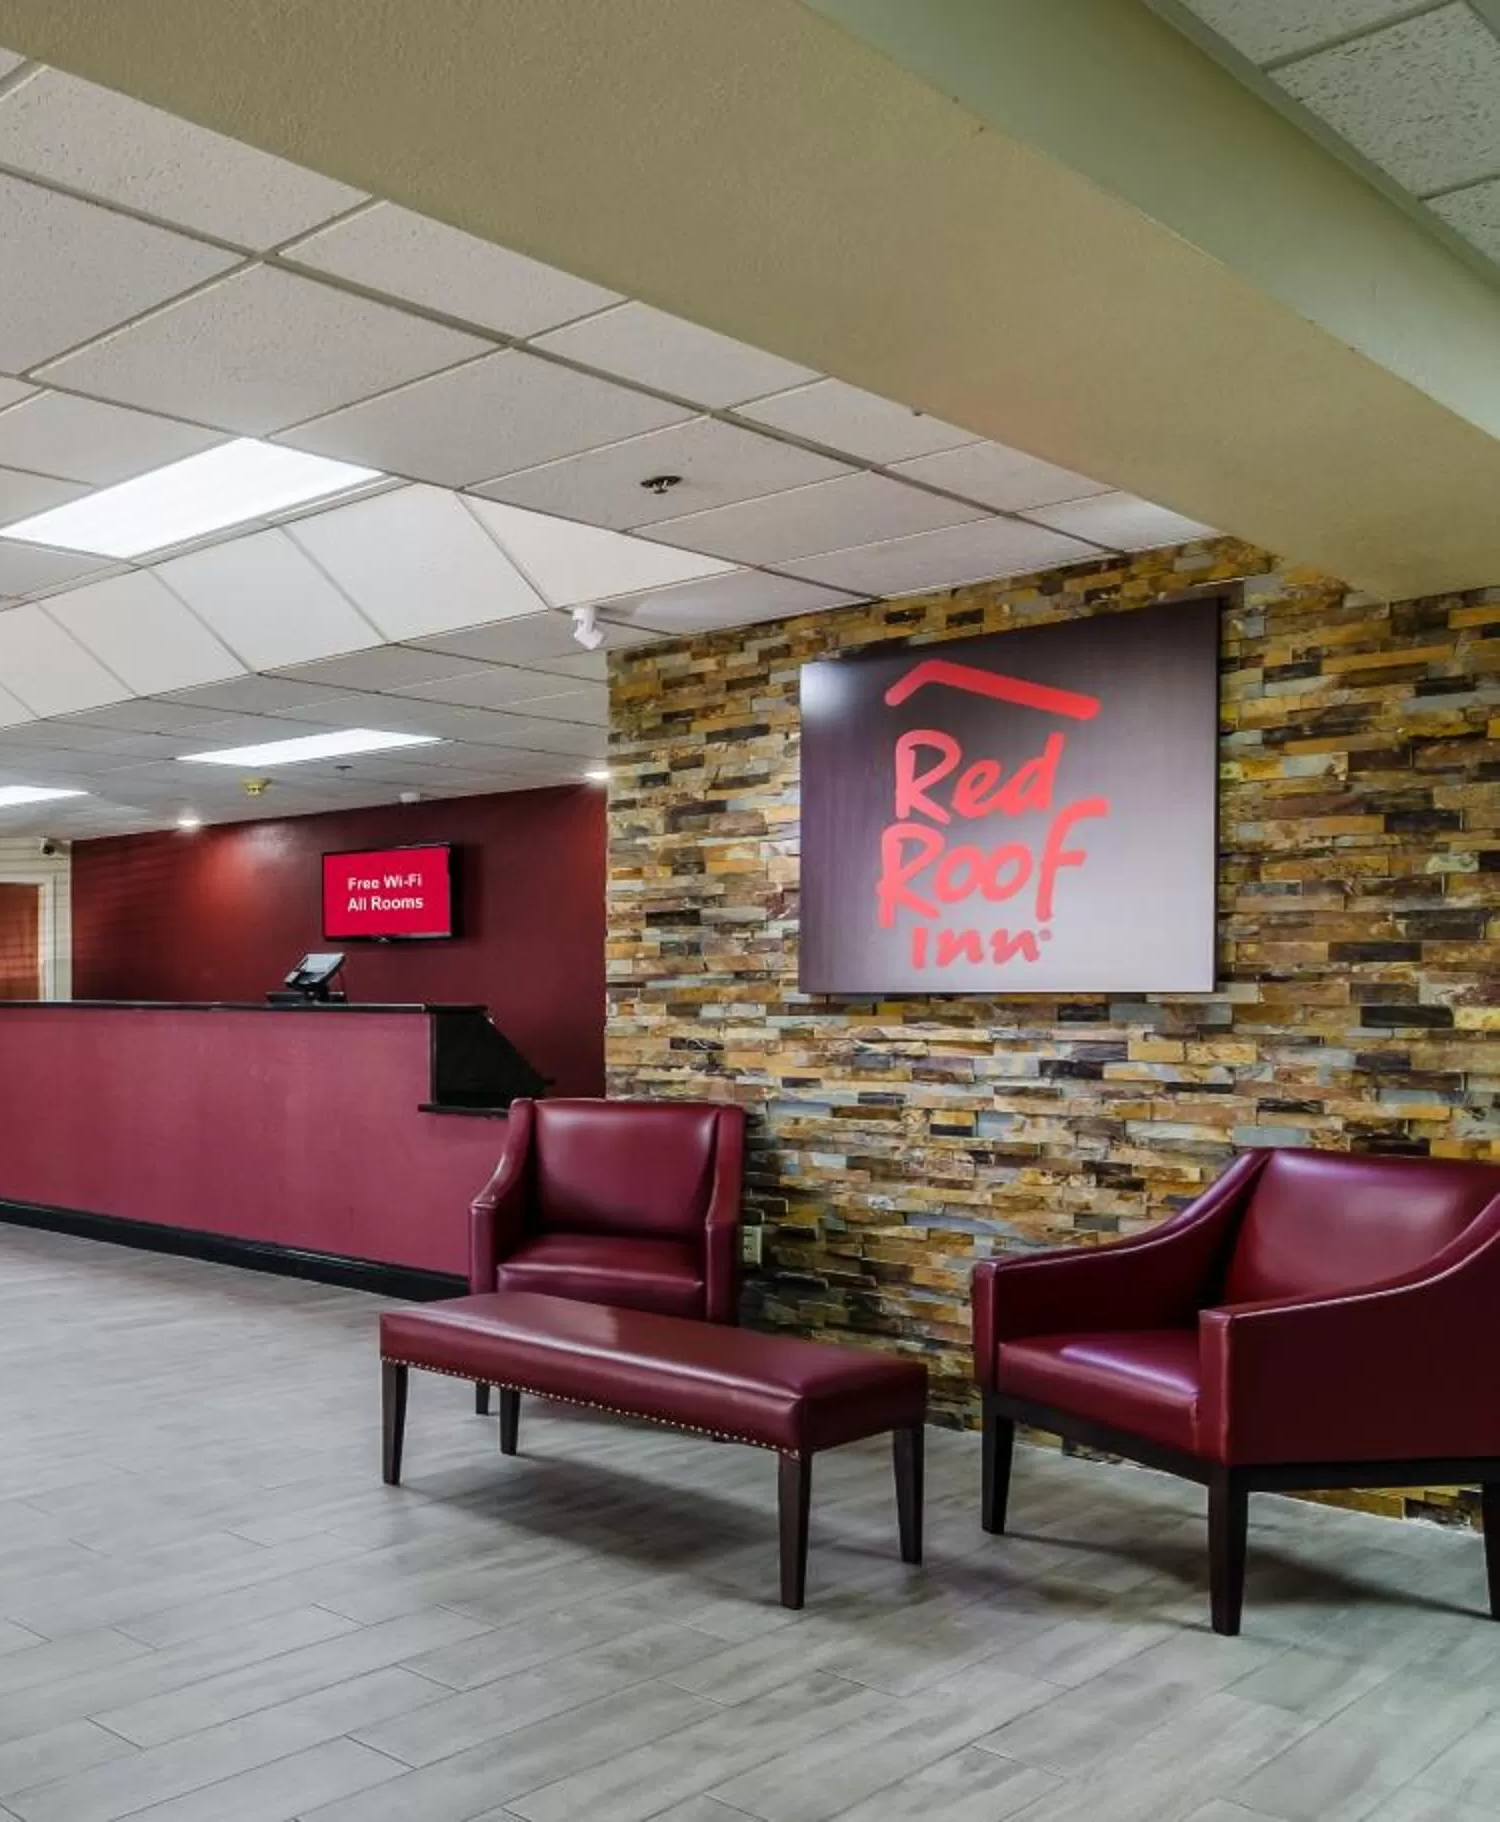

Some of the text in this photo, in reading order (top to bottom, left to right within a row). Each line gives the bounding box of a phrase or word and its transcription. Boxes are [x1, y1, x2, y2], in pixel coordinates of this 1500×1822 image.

[896, 730, 1064, 824] Red
[347, 873, 422, 890] Free Wi-Fi
[877, 796, 1109, 929] Roof
[347, 896, 424, 912] All Rooms
